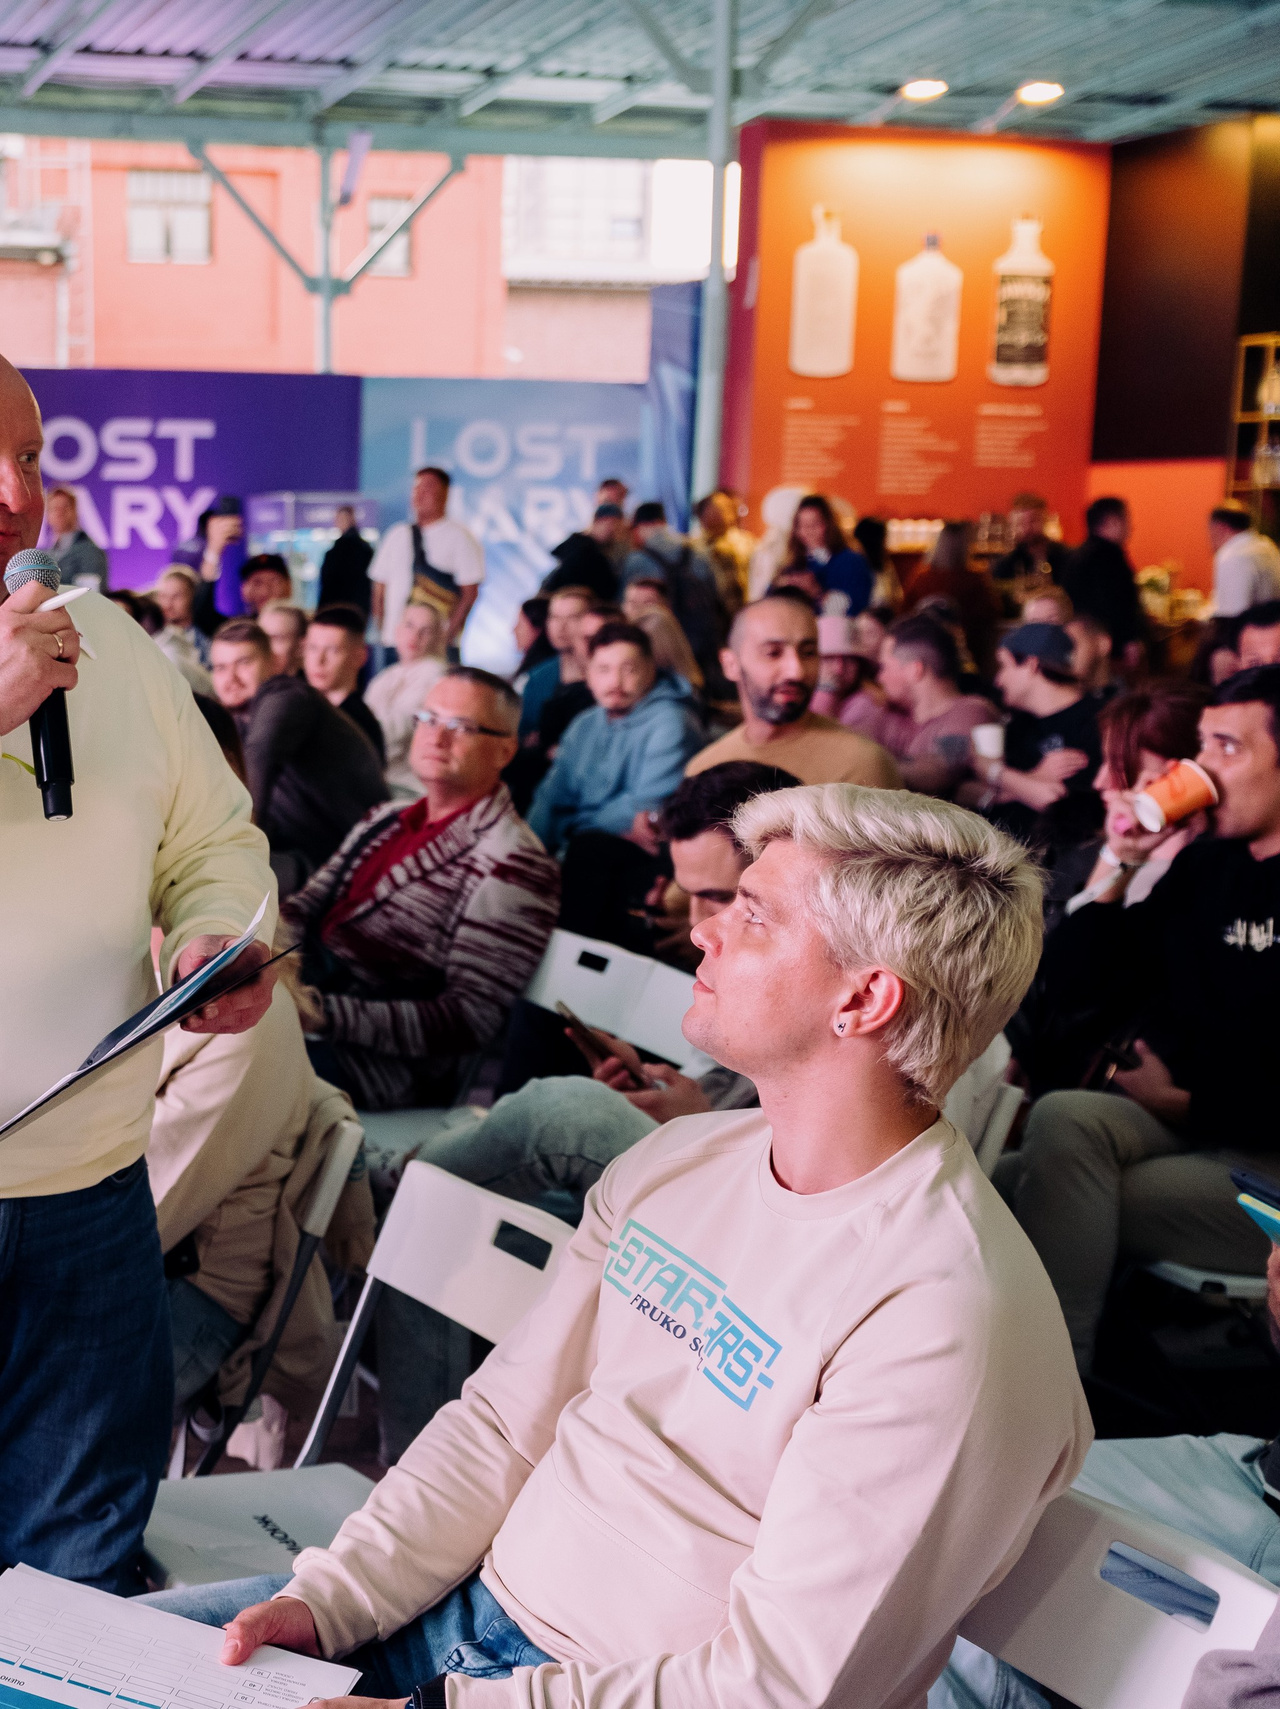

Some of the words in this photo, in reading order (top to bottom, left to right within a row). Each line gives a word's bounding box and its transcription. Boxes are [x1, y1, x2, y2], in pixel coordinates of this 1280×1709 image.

[38, 415, 218, 482] OST
[411, 417, 618, 480] LOST
[35, 484, 218, 550] ARY
[629, 1293, 687, 1340] FRUKO
